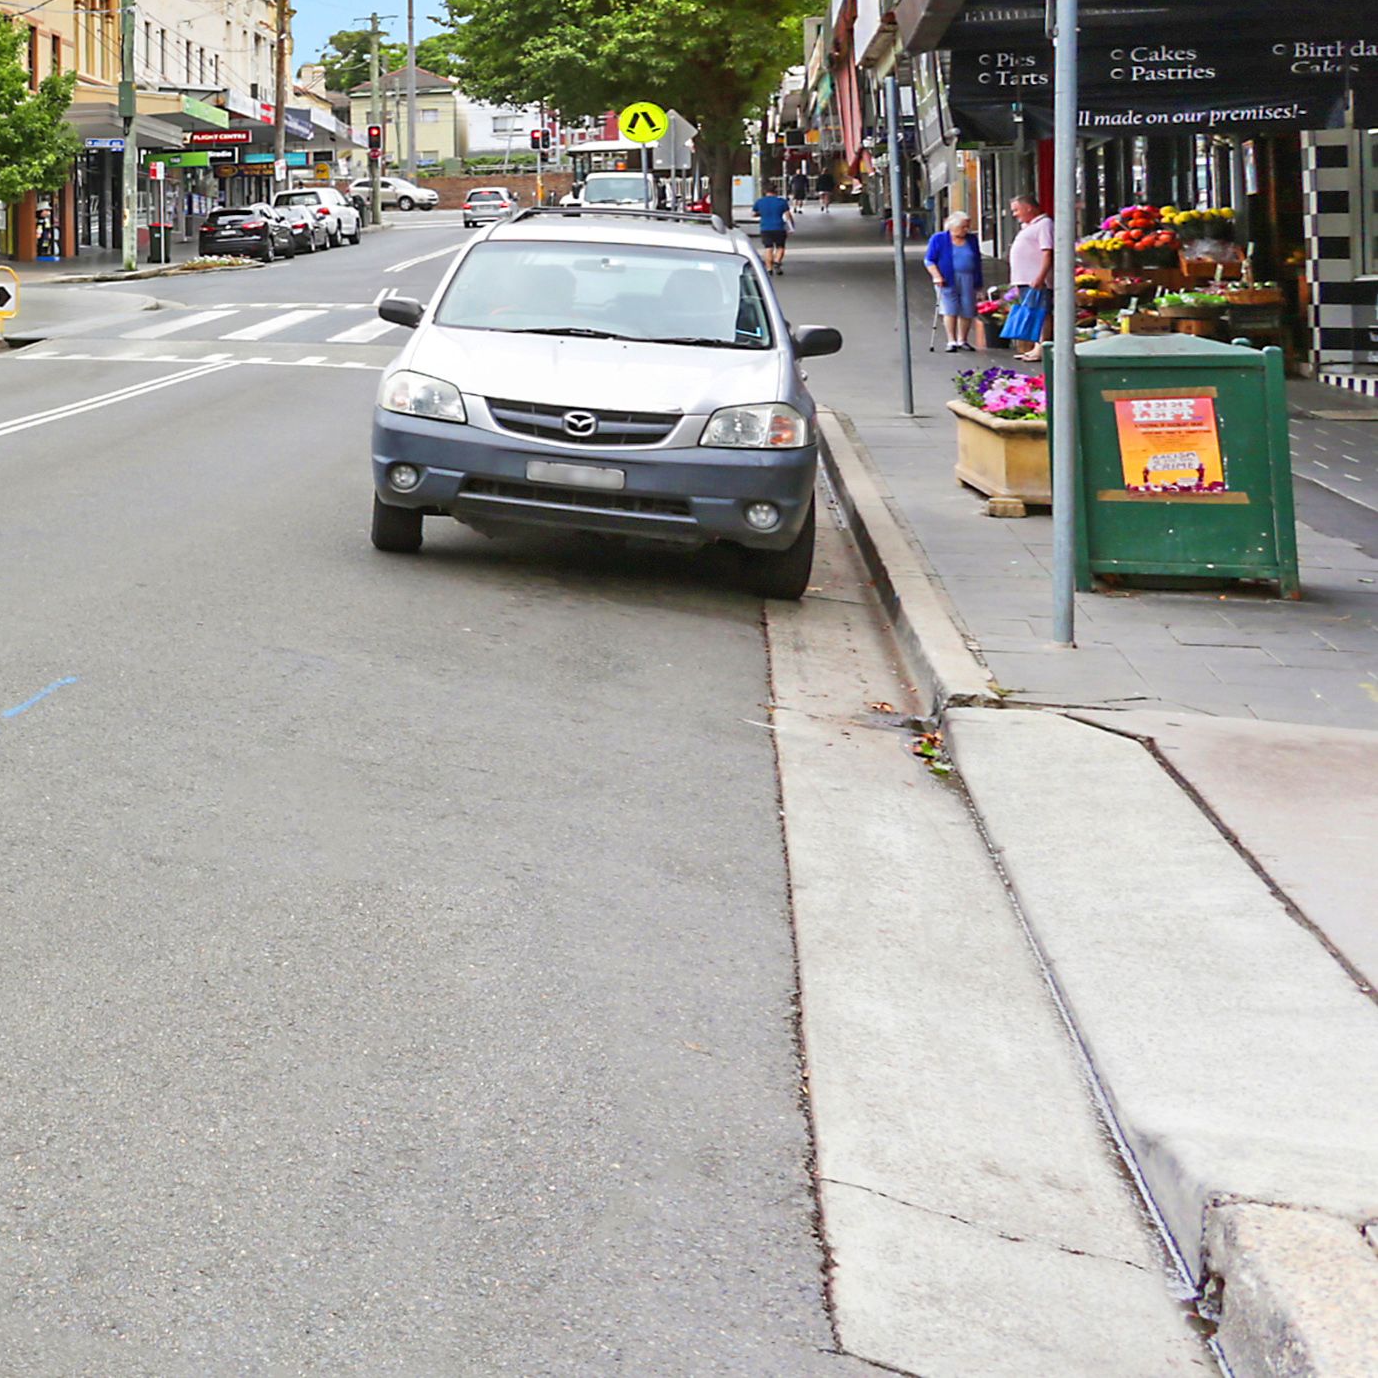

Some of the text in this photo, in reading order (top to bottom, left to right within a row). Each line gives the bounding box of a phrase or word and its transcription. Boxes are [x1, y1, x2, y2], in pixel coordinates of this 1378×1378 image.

[1130, 45, 1197, 62] Cakes
[995, 70, 1049, 86] Tarts
[1131, 64, 1216, 81] Pastries
[1093, 109, 1143, 127] made
[1145, 112, 1169, 125] on
[1172, 109, 1205, 124] our
